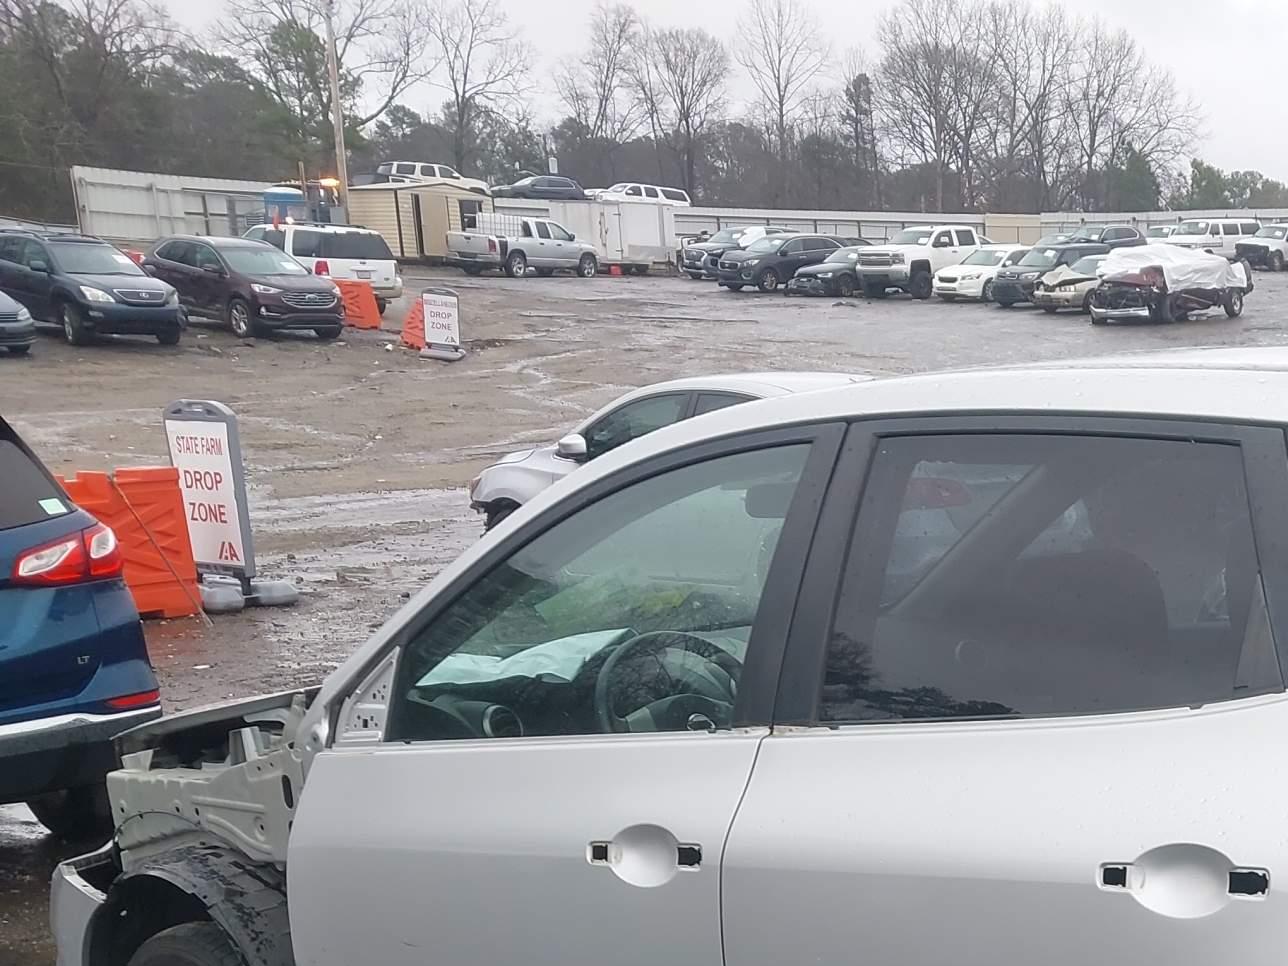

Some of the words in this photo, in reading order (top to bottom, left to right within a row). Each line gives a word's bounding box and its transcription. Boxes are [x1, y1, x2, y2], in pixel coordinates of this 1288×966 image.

[430, 310, 453, 319] DROP
[431, 321, 453, 331] ZONE
[176, 436, 200, 454] STATE
[200, 437, 223, 456] FARM
[184, 470, 222, 490] DROP
[189, 502, 228, 523] ZONE
